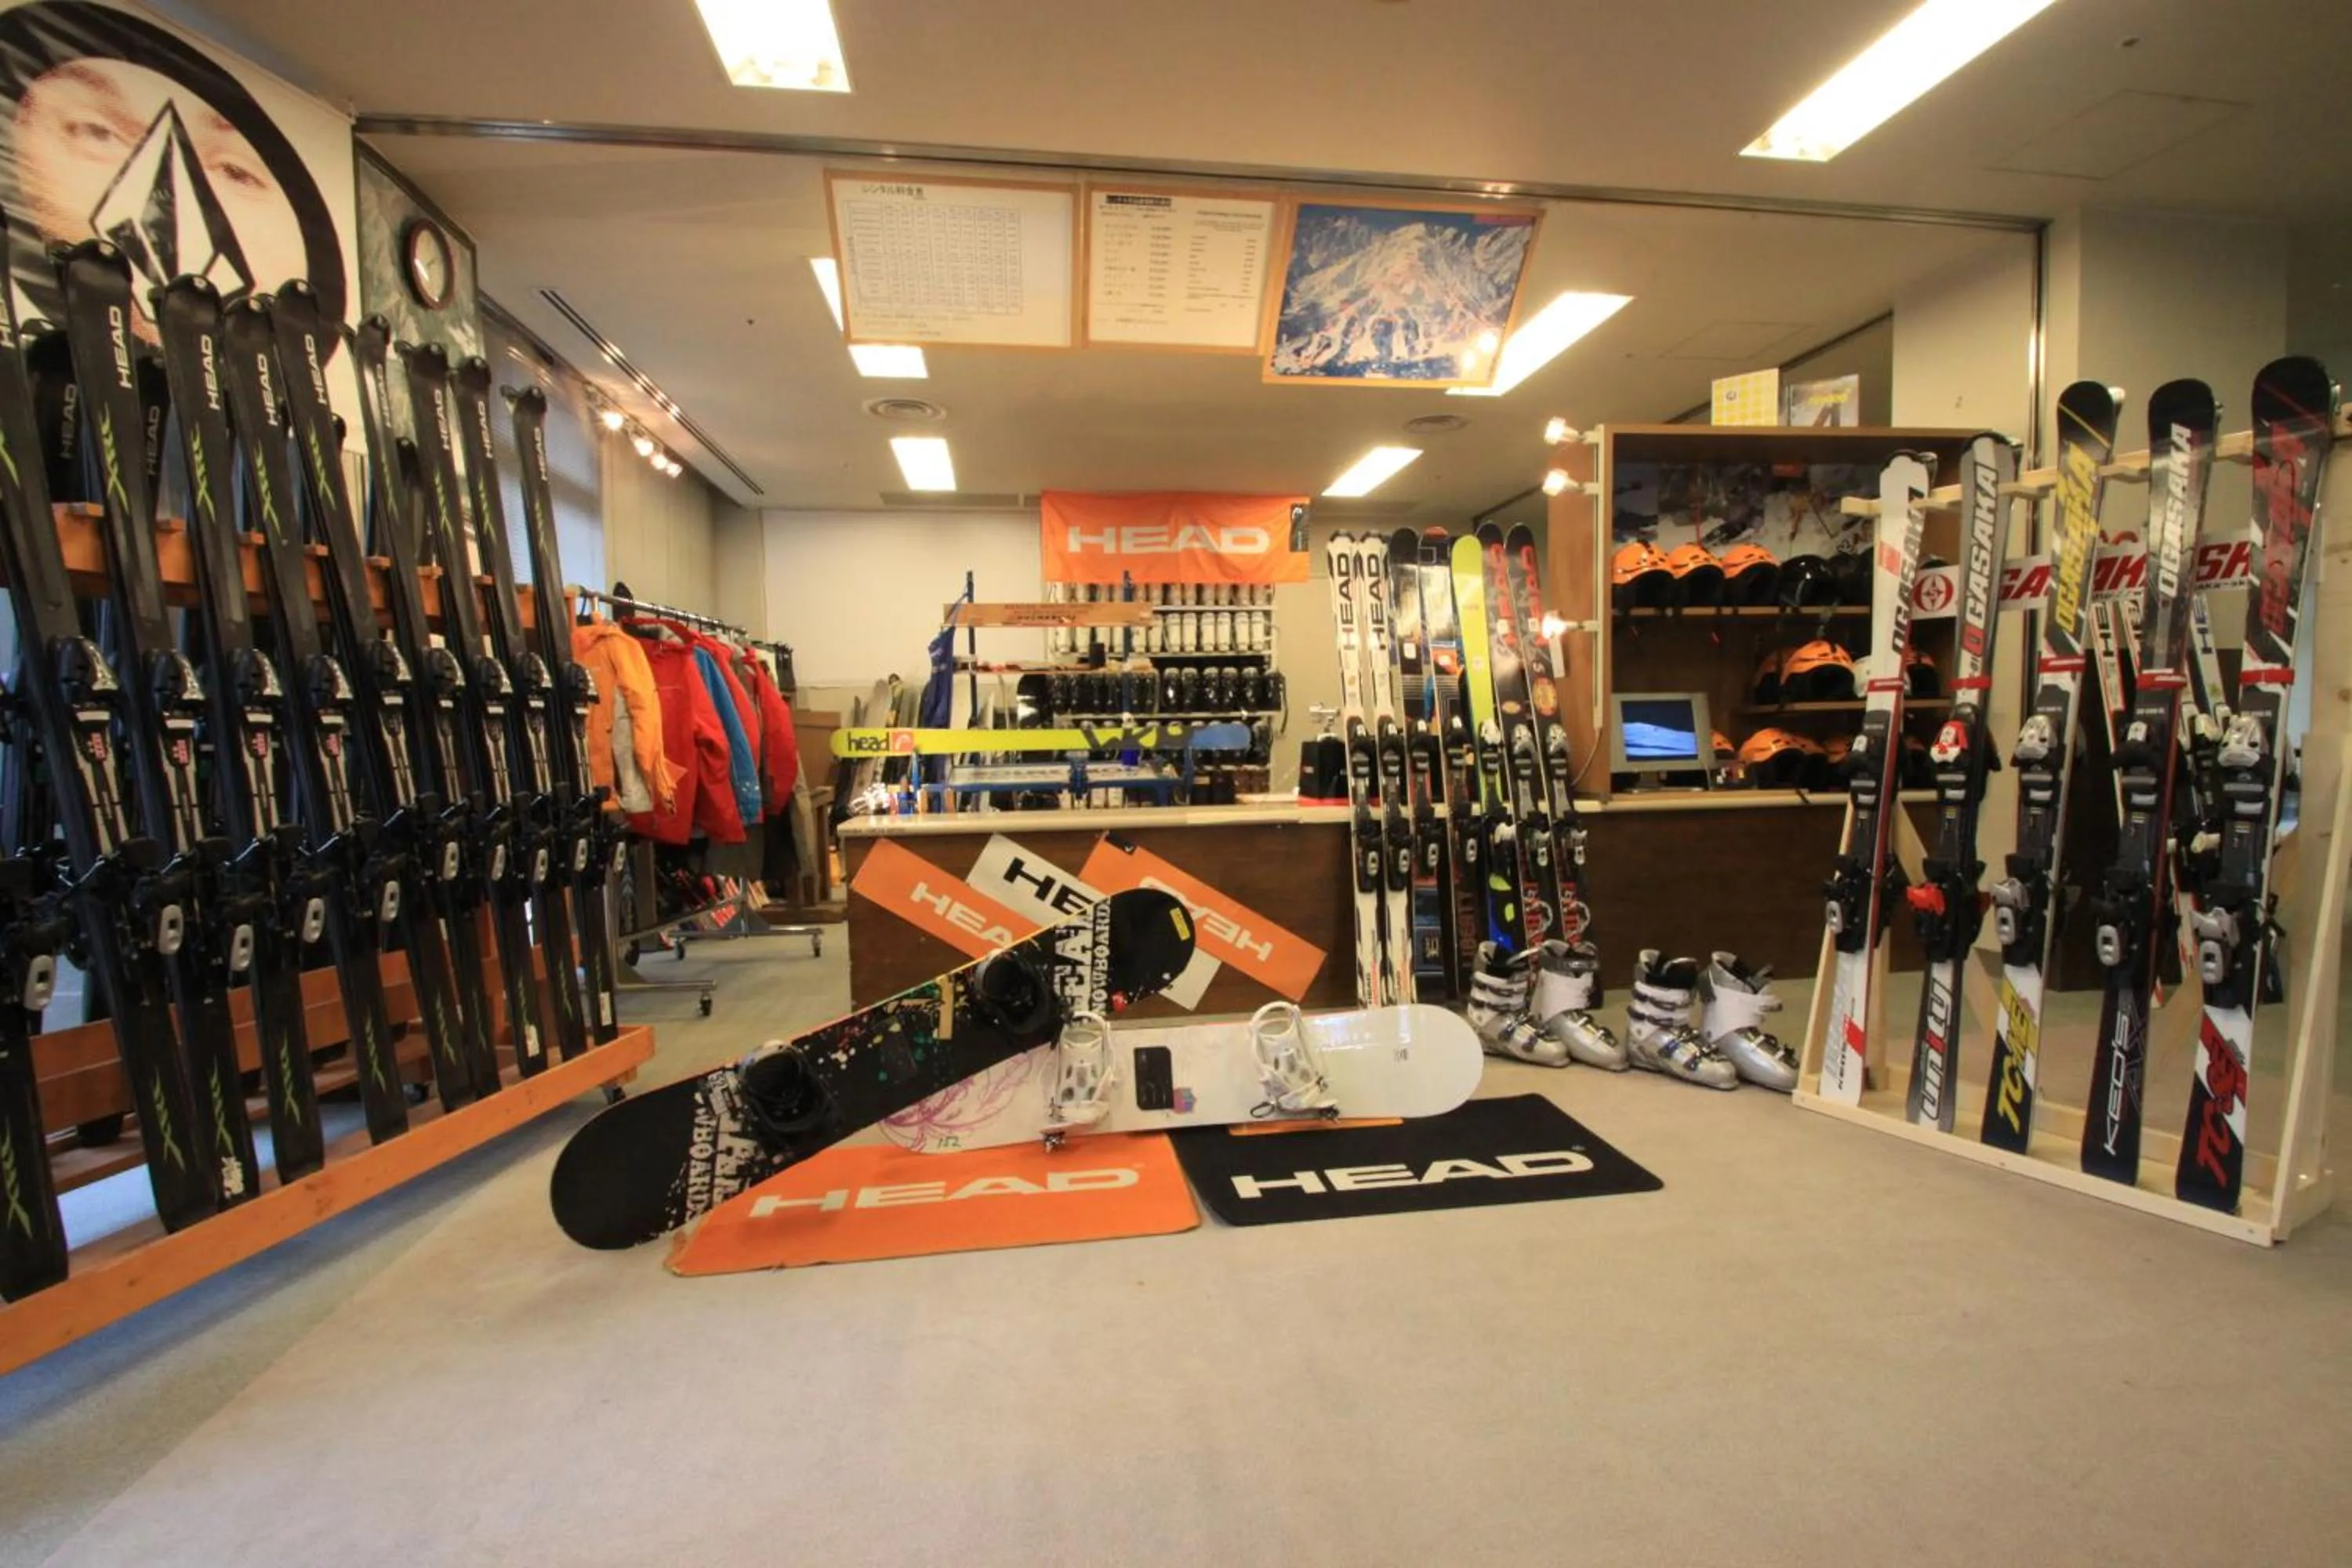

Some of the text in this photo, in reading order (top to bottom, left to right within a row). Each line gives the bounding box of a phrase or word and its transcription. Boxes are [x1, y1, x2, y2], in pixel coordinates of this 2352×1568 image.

[109, 305, 132, 389] HEAD
[201, 334, 220, 411] HEAD
[304, 334, 328, 405] HEAD
[60, 383, 77, 459] HEAD
[257, 354, 278, 426] HEAD
[434, 389, 451, 451] HEAD
[477, 401, 493, 459] HEAD
[534, 426, 548, 481] HEAD
[1068, 525, 1270, 554] HEAD
[2158, 423, 2191, 598] OGASAKA
[1962, 462, 1998, 656] OGASAKA
[1338, 553, 1355, 650] HEAD
[1367, 554, 1387, 650] HEAD
[848, 731, 889, 751] head
[910, 882, 1013, 946] HEA
[749, 1167, 1139, 1217] HEAD
[1231, 1151, 1595, 1199] HEAD
